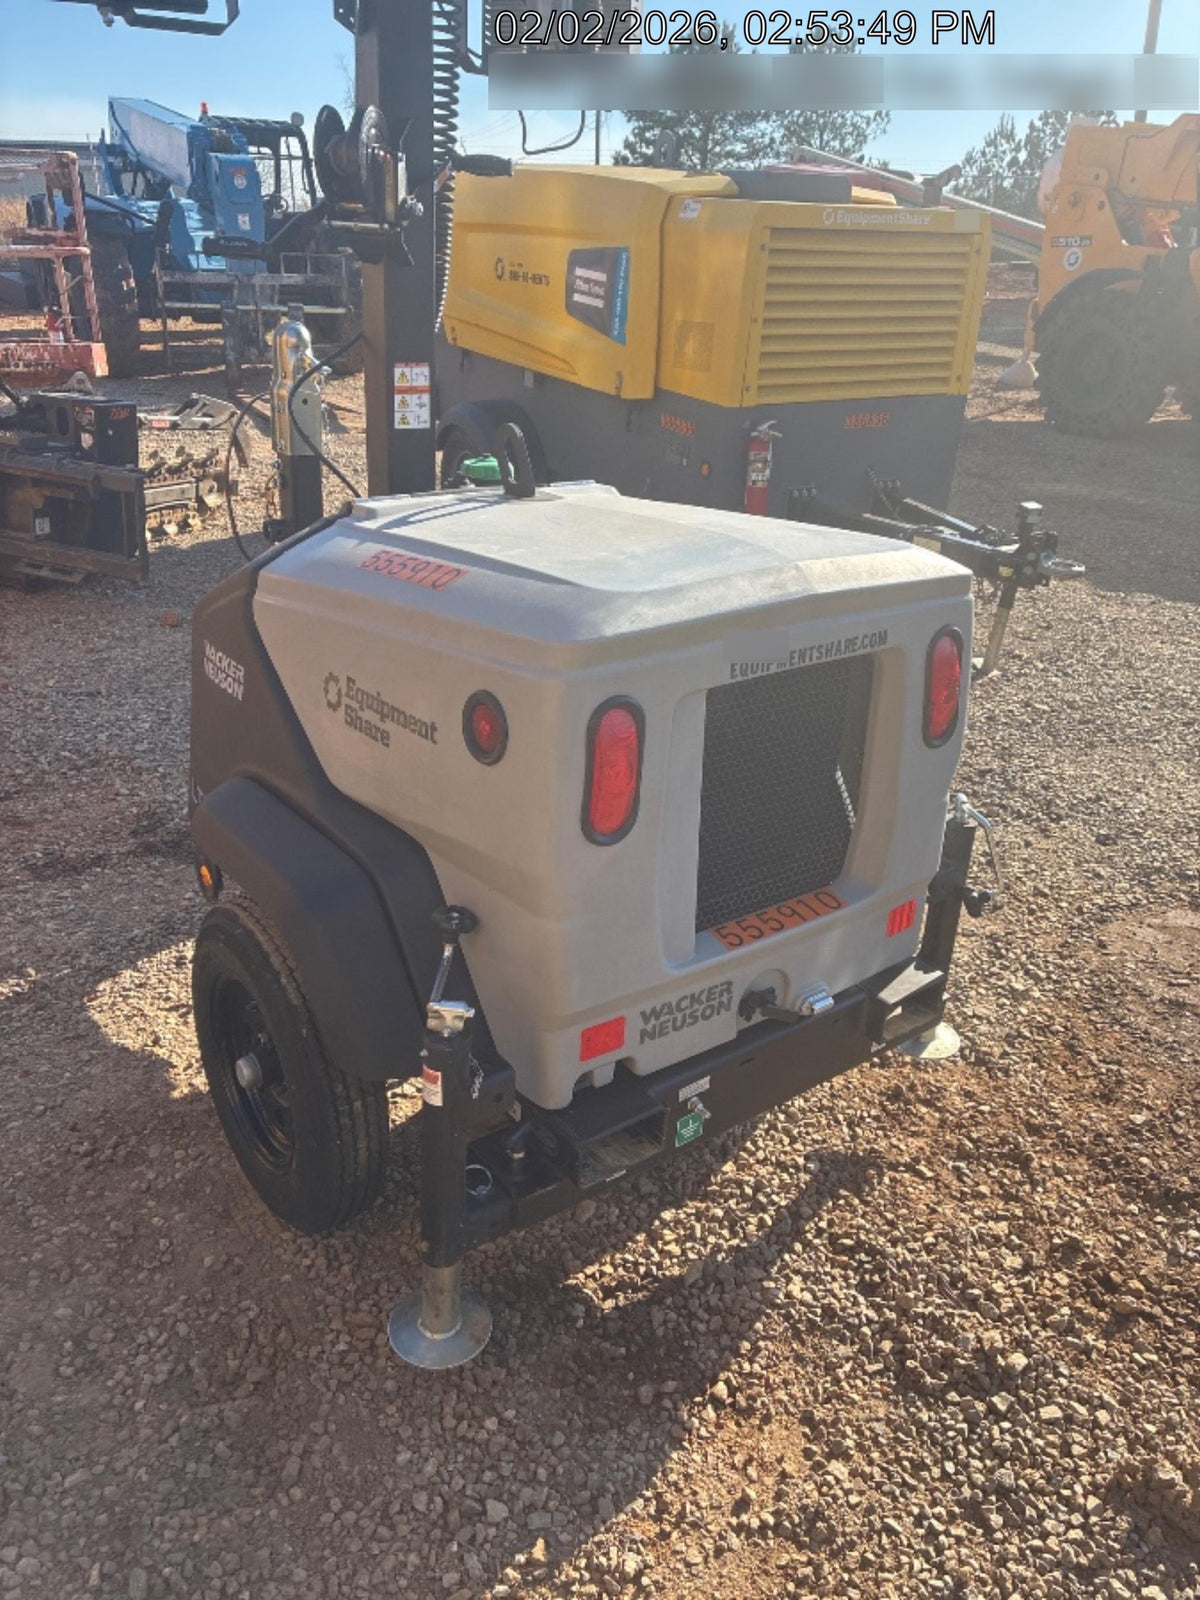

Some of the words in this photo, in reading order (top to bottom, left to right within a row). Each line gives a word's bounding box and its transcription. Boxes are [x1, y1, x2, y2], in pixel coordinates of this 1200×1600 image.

[836, 209, 931, 226] EquipmentShare
[362, 550, 462, 589] 555910
[203, 640, 245, 684] WACKER
[203, 656, 245, 701] NEUSON
[344, 675, 439, 745] Equipment
[344, 703, 391, 748] Share
[714, 890, 842, 947] 555910
[639, 980, 734, 1026] WACKER
[639, 996, 734, 1045] NEUSON
